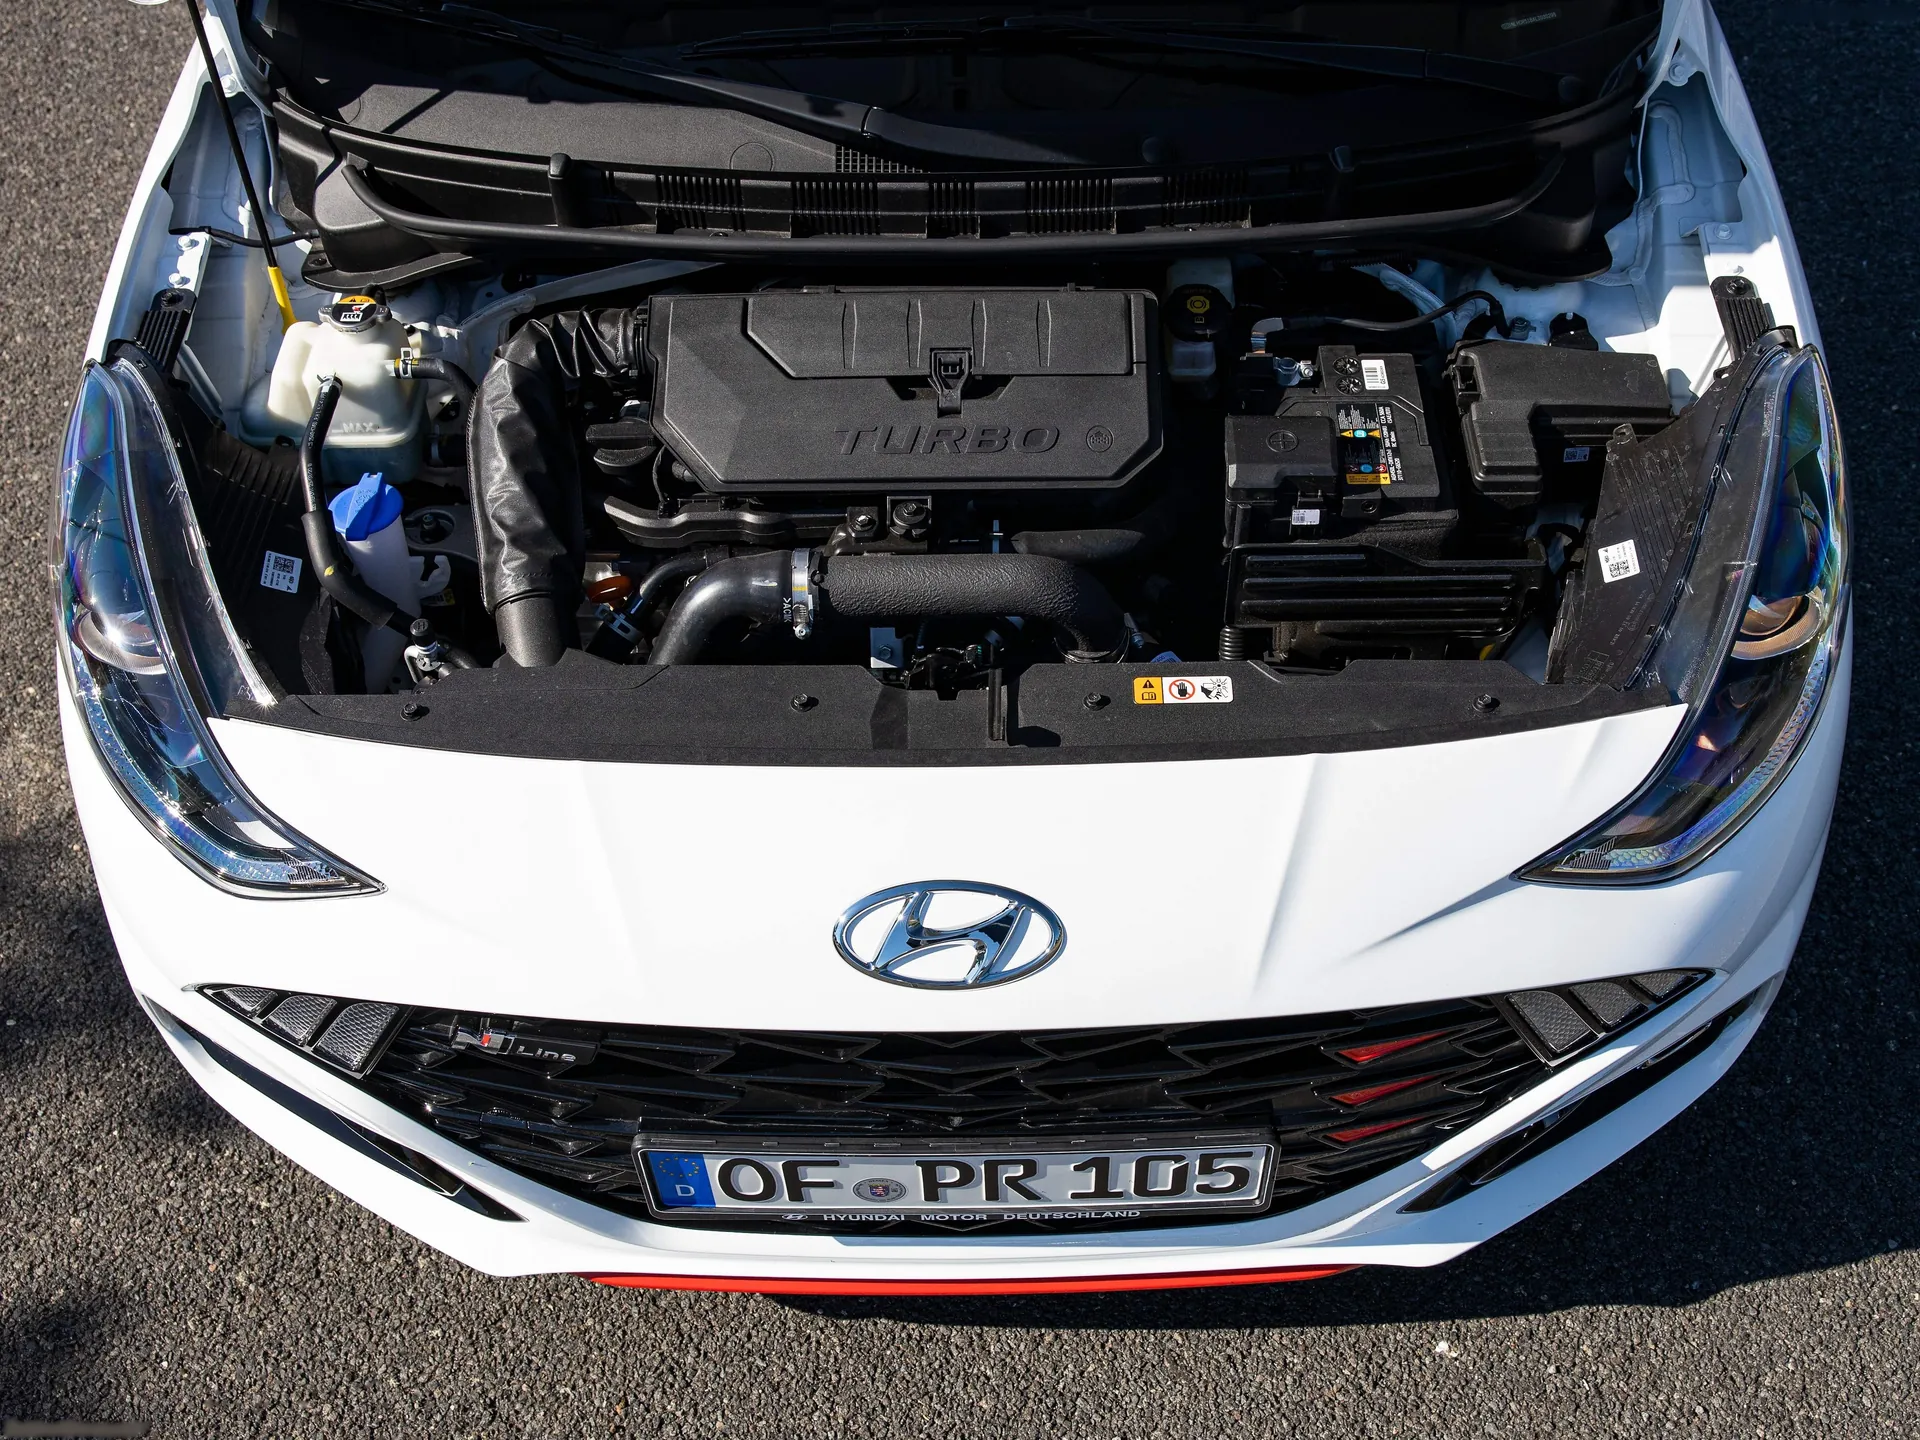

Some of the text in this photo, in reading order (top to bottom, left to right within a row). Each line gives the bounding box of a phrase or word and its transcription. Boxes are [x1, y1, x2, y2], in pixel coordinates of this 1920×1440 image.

[342, 422, 375, 433] MAX
[834, 425, 1060, 455] TURBO
[516, 1045, 577, 1062] Line
[717, 1151, 1254, 1203] OF PR 105
[675, 1184, 695, 1197] D
[920, 1213, 988, 1221] MOTOR
[1003, 1210, 1141, 1221] DEUTSCHLAND
